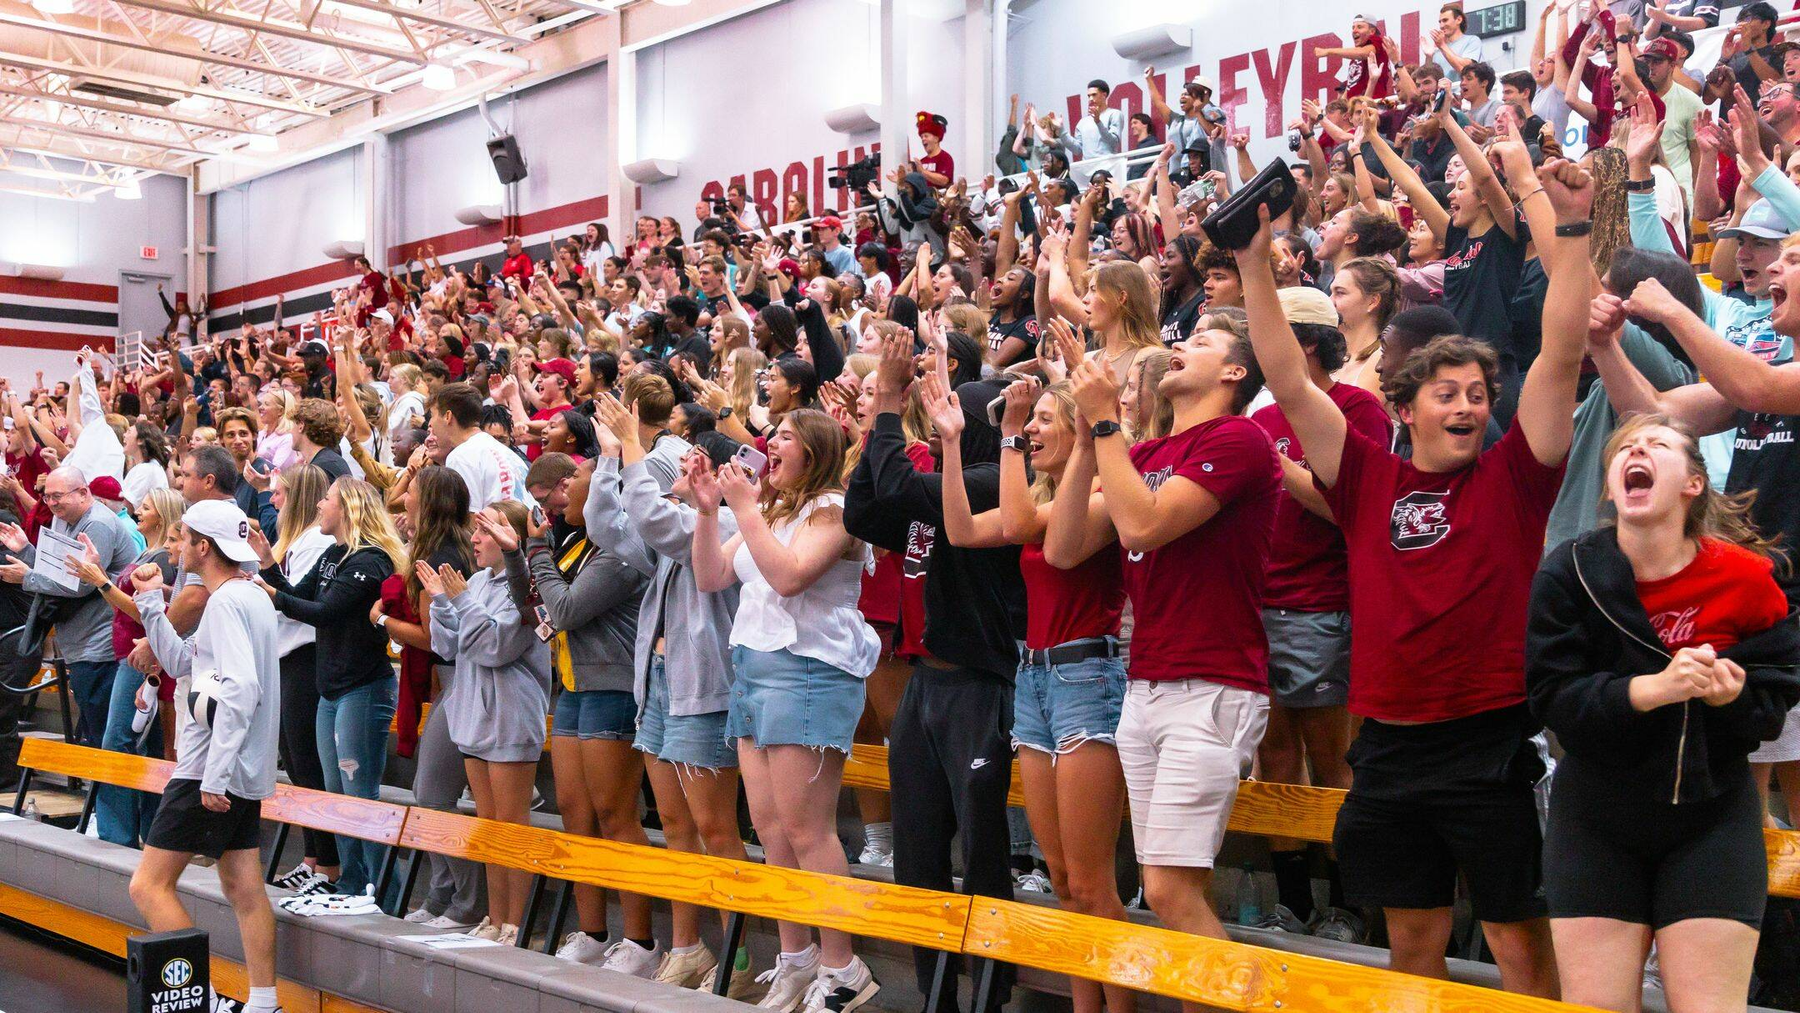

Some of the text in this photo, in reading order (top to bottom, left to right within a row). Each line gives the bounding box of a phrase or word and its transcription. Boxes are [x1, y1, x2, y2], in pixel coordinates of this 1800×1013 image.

[1476, 3, 1517, 34] 7:38
[163, 960, 191, 987] SEC
[151, 985, 204, 1004] VIDEO
[151, 996, 204, 1013] REVIEW
